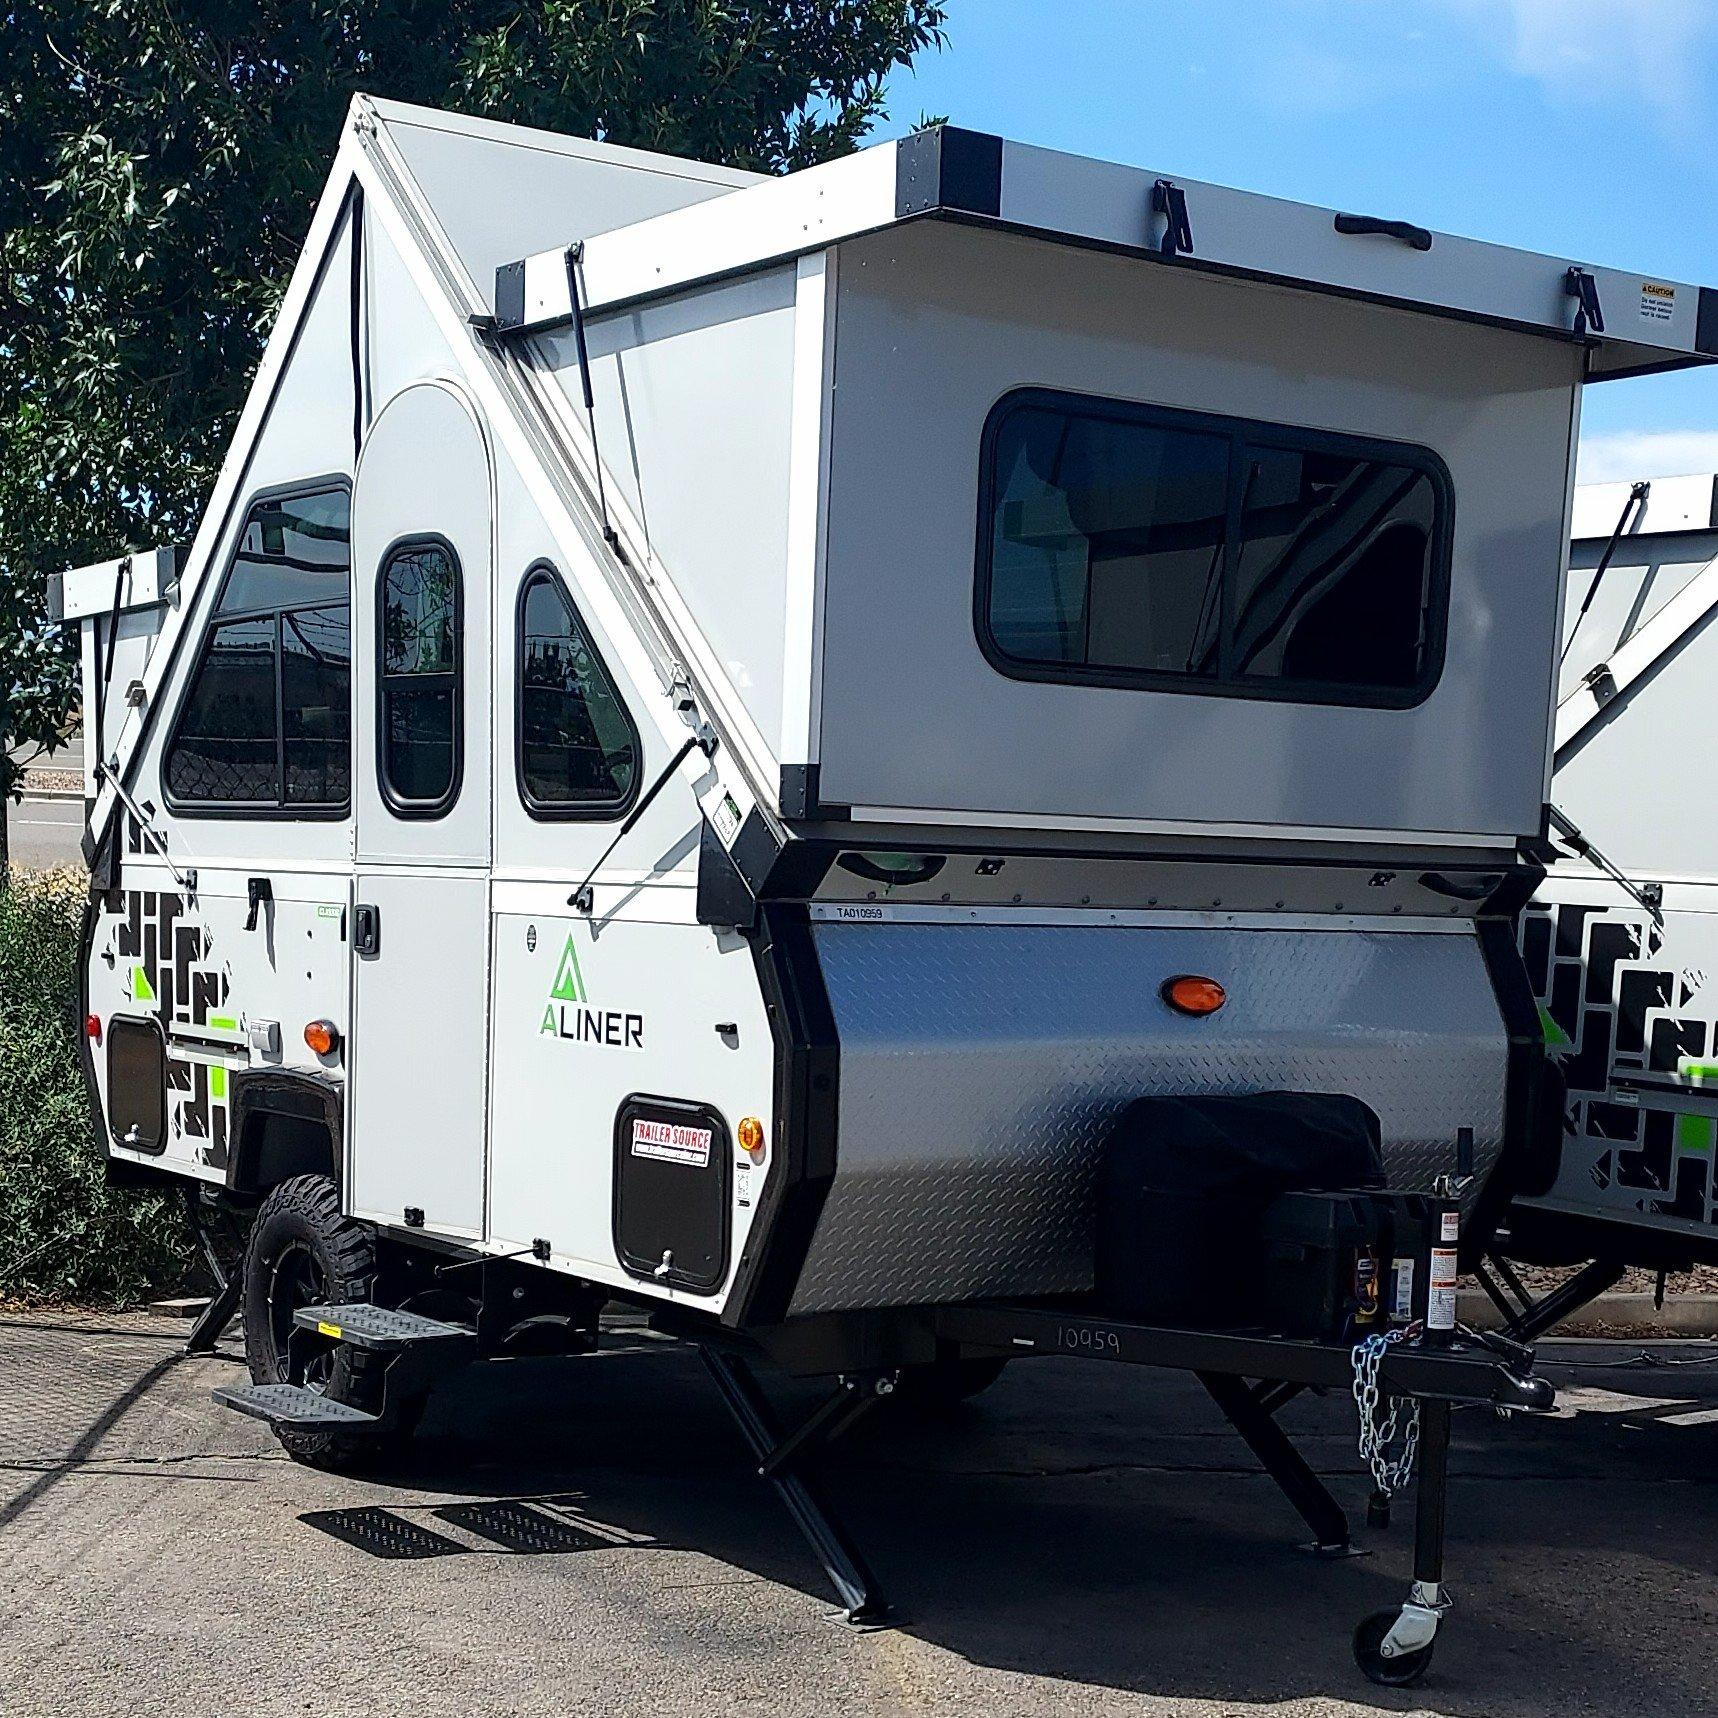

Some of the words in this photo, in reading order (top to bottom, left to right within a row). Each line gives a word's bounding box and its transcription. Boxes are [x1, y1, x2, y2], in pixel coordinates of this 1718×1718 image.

[1648, 285, 1674, 298] CAUTION
[837, 907, 883, 919] TA010959
[540, 1003, 643, 1049] ALINER
[635, 1122, 671, 1144] TRAILER
[673, 1128, 709, 1150] SOURCE
[1058, 1326, 1120, 1354] 10959
